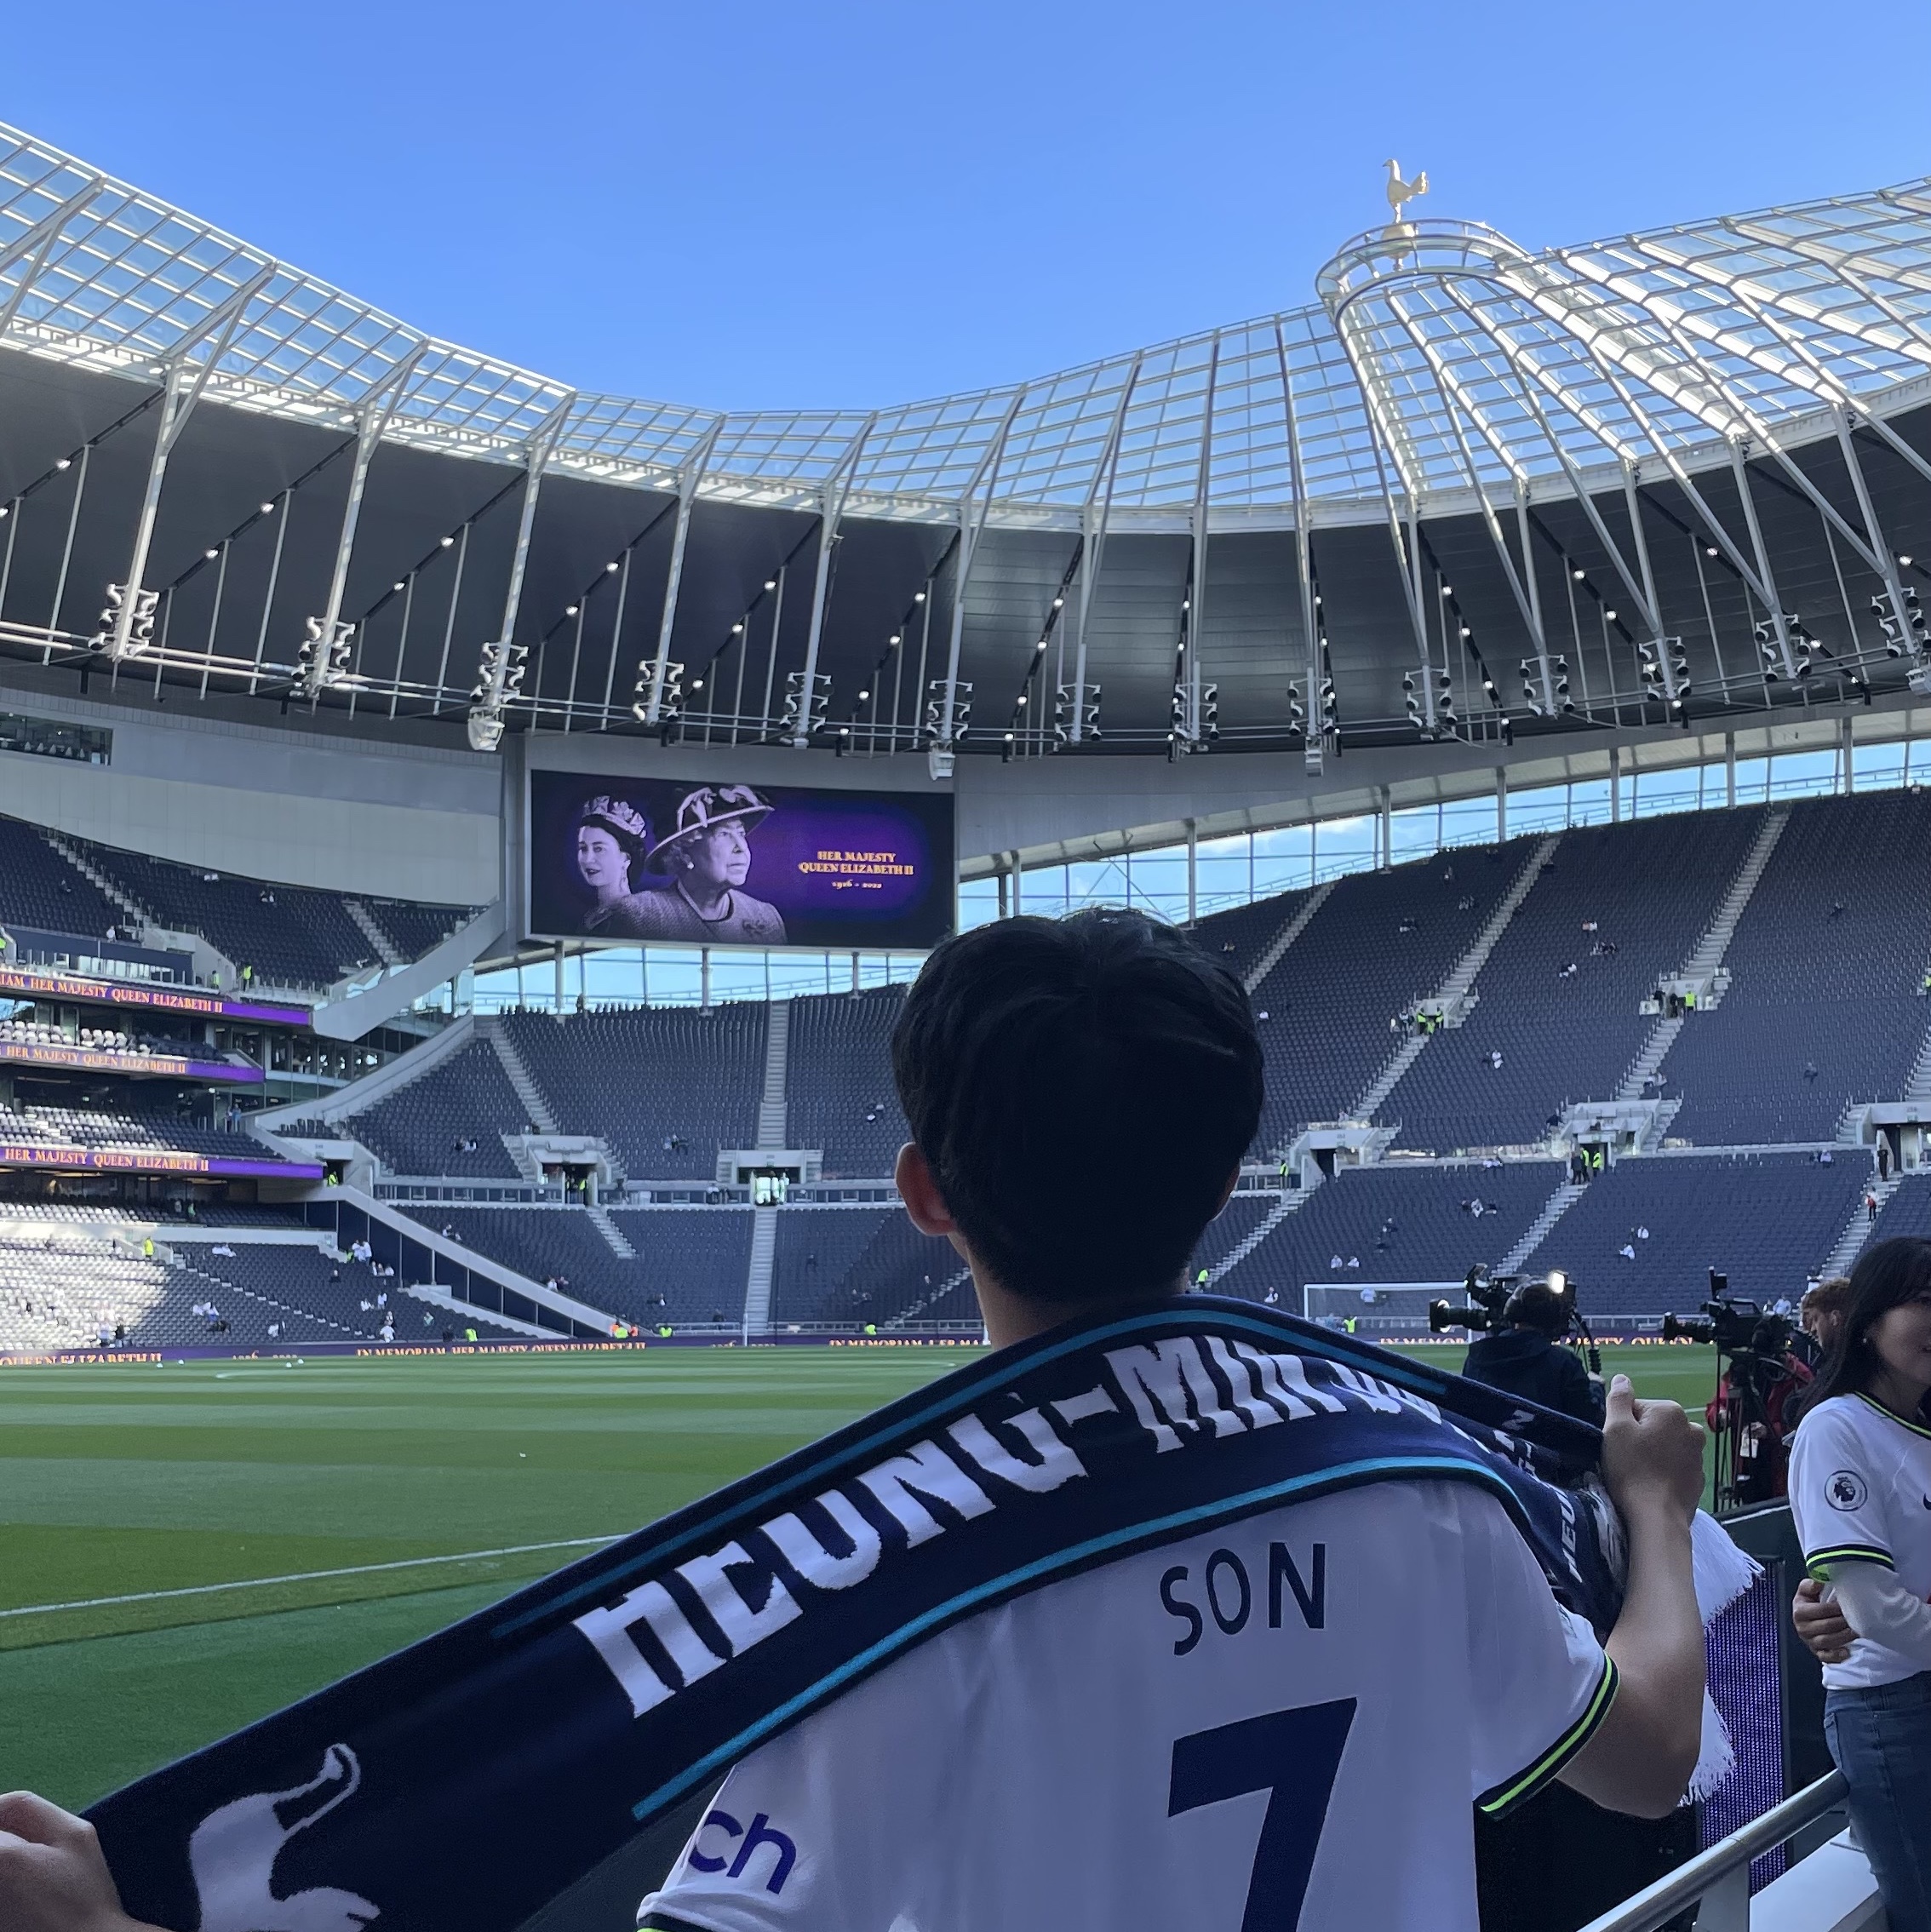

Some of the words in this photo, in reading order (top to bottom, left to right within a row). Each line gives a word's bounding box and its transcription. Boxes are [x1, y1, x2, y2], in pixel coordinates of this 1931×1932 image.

[798, 862, 839, 874] QUEEN
[839, 863, 902, 874] ELIZABETH
[904, 865, 914, 875] II
[817, 851, 842, 861] HER
[844, 851, 896, 863] MAJESTY
[0, 973, 25, 988] IAM
[30, 977, 54, 991] HER
[57, 981, 107, 998] MAJESTY
[112, 988, 151, 1003] QUEEN
[153, 993, 211, 1012] ELIZABETH
[215, 1001, 223, 1013] II
[7, 1046, 29, 1058] HER
[33, 1048, 79, 1063] MAJESTY
[83, 1054, 117, 1067] QUEEN
[121, 1058, 175, 1073] ELIZABETH
[178, 1063, 186, 1073] II
[5, 1148, 31, 1161] HER
[35, 1149, 88, 1165] MAJESTY
[94, 1153, 133, 1168] QUEEN
[136, 1155, 198, 1172] ELIZABETH
[200, 1159, 209, 1172] II
[1160, 1541, 1326, 1656] SON
[1168, 1697, 1358, 1932] 7
